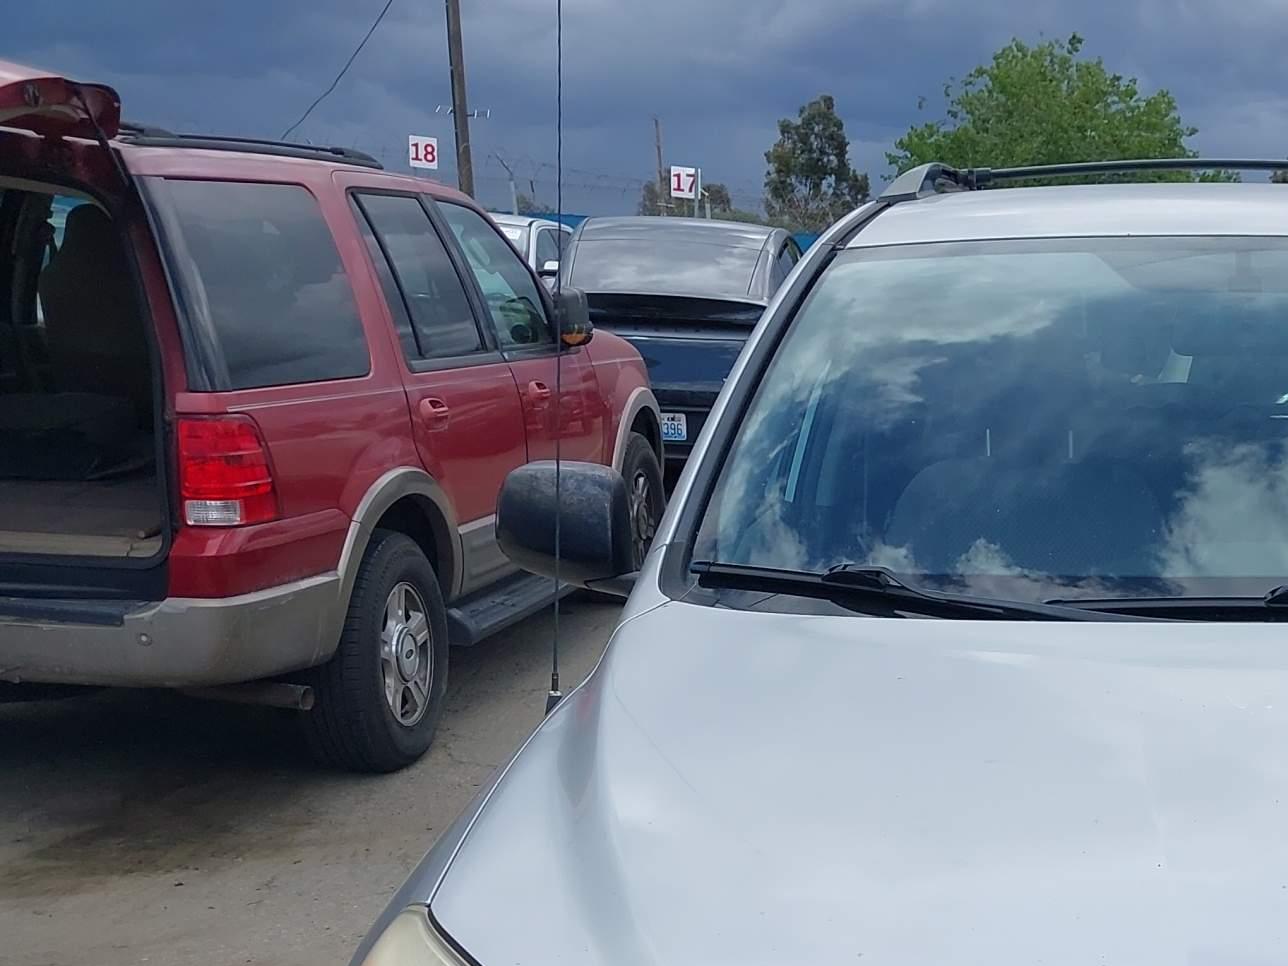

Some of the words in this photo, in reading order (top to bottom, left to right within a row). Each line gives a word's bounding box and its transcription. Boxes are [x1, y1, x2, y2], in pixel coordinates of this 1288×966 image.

[411, 143, 435, 163] 18
[673, 173, 696, 193] 17
[663, 423, 682, 435] 396
